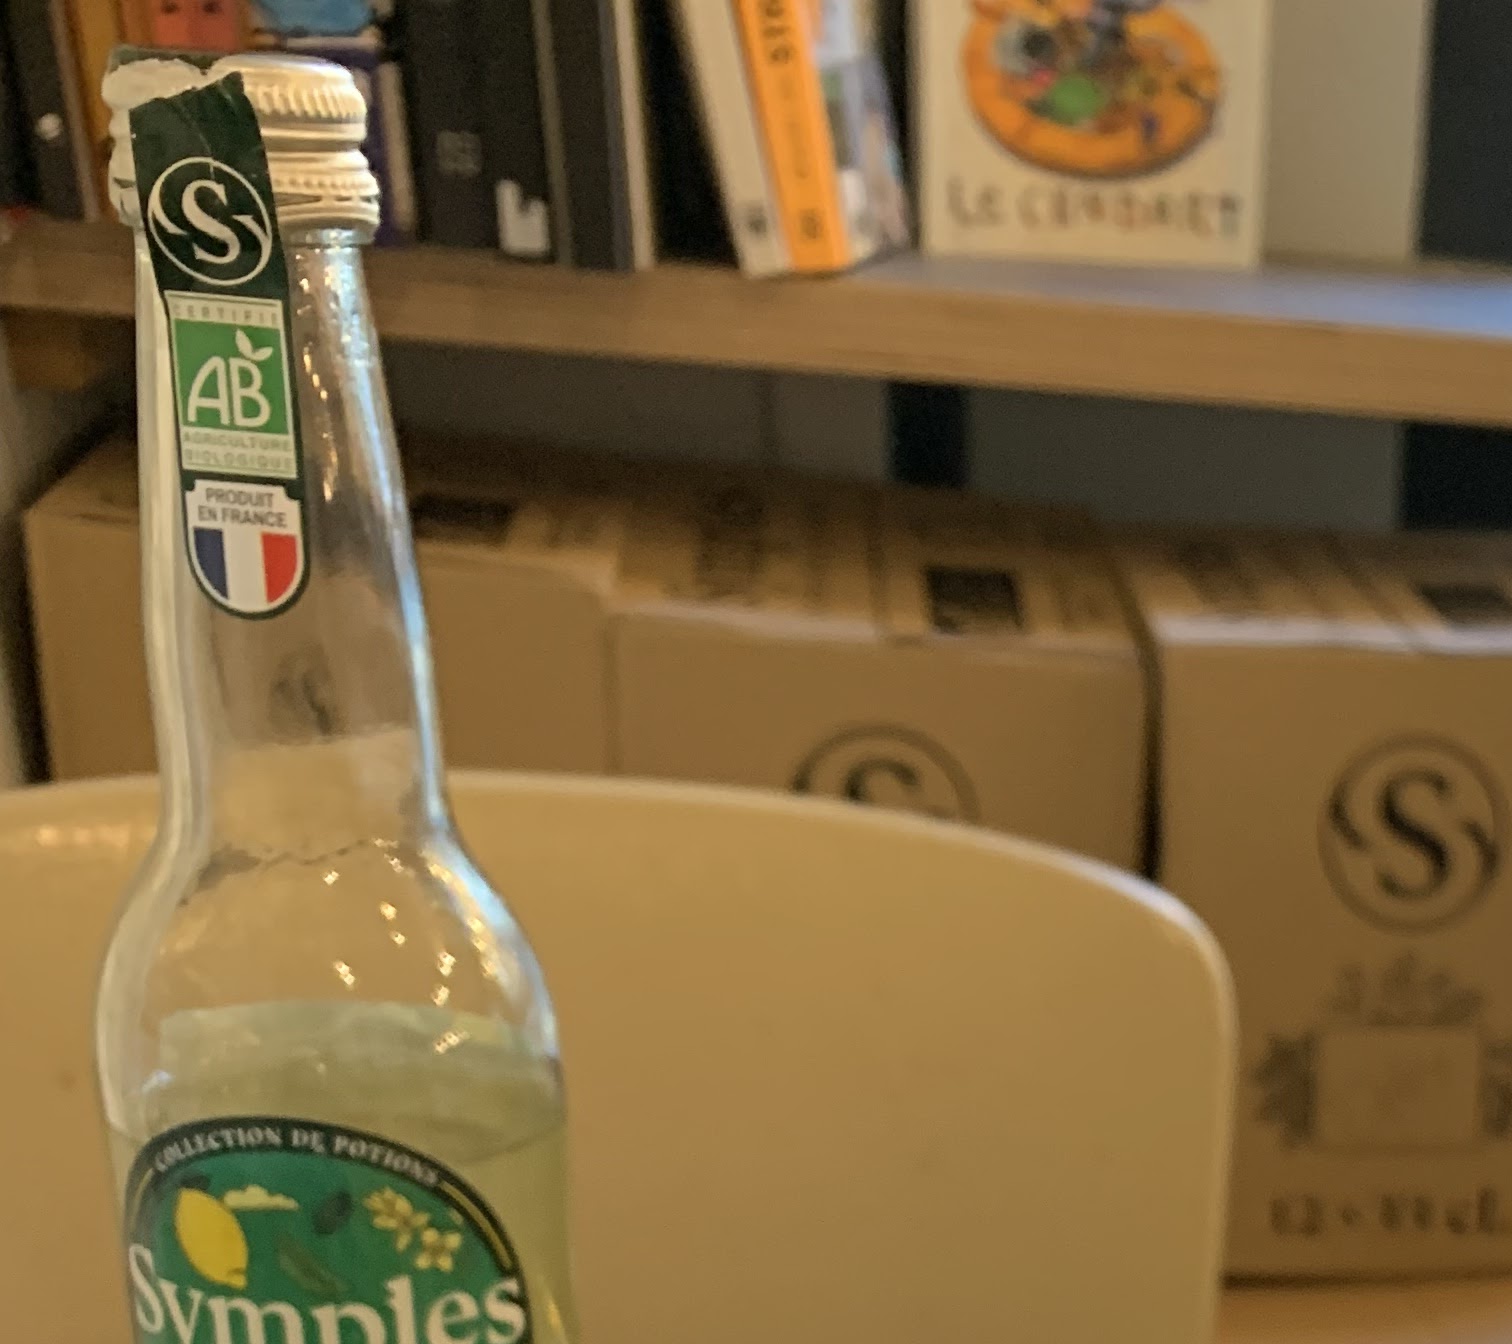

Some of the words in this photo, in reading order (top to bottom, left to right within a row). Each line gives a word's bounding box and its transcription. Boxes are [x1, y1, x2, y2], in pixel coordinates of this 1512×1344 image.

[187, 356, 271, 427] AB
[198, 505, 218, 522] EN
[221, 507, 287, 528] FRANCE
[205, 487, 274, 508] PRODUIT
[155, 1126, 283, 1172] COLLECTION
[290, 1127, 327, 1154] DE
[334, 1133, 441, 1186] POTIONS
